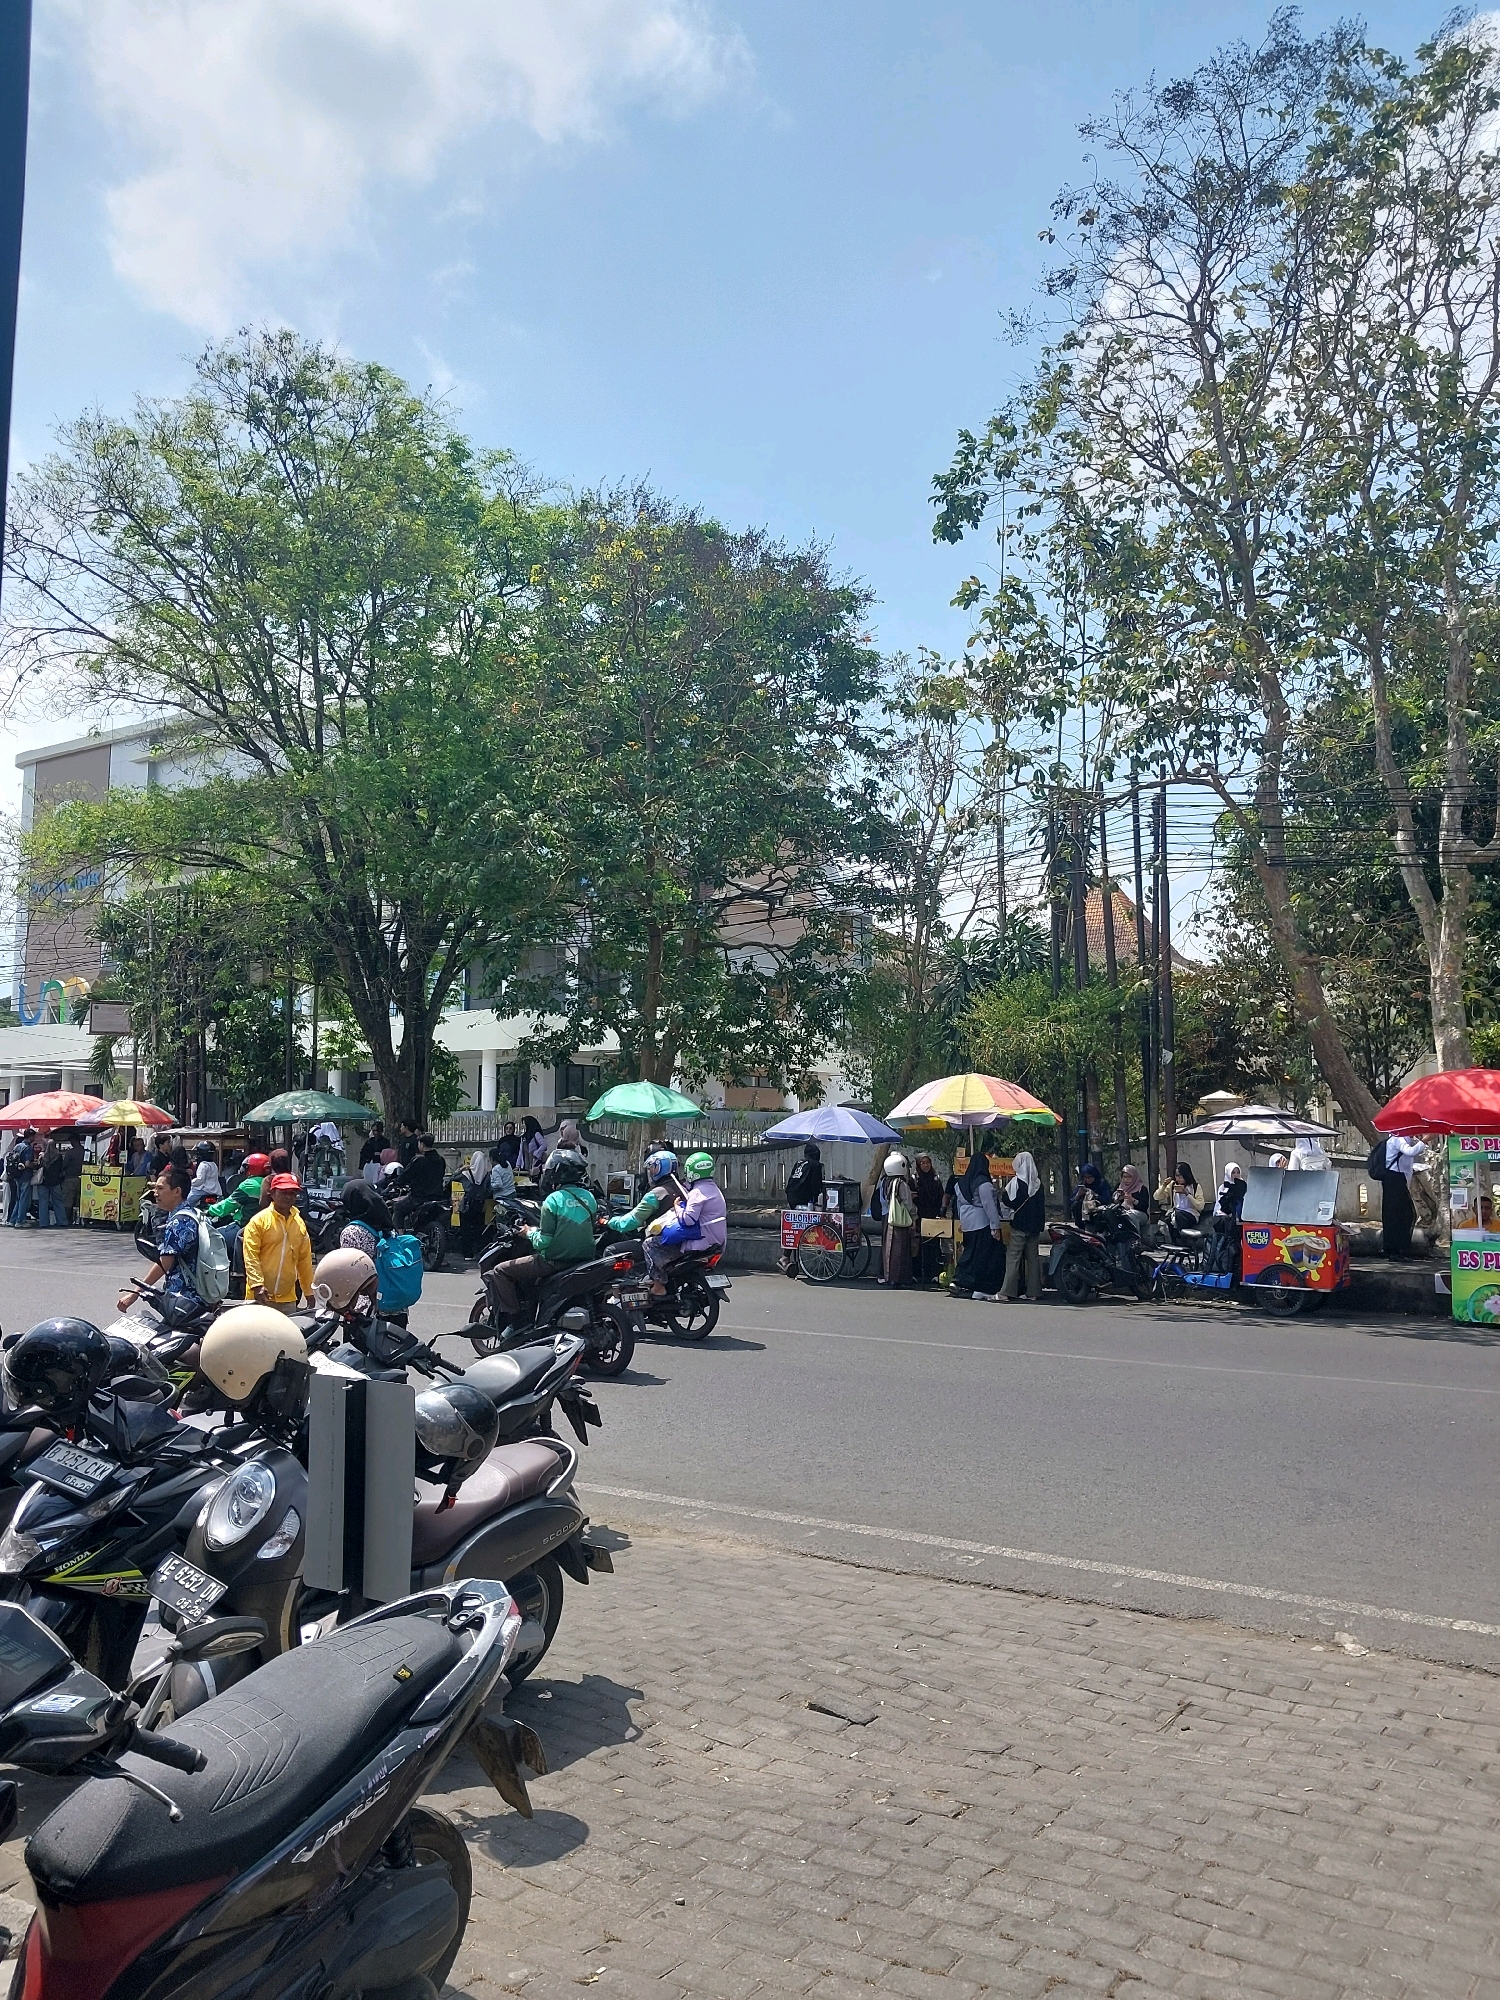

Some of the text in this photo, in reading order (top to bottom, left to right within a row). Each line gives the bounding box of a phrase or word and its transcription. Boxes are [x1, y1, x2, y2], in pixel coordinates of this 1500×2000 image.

[1459, 1137, 1480, 1153] ES
[1457, 1250, 1480, 1270] ES
[46, 1446, 111, 1480] B 3252 CKK
[53, 1550, 92, 1574] HONDA
[158, 1557, 224, 1604] AE 6252 DN
